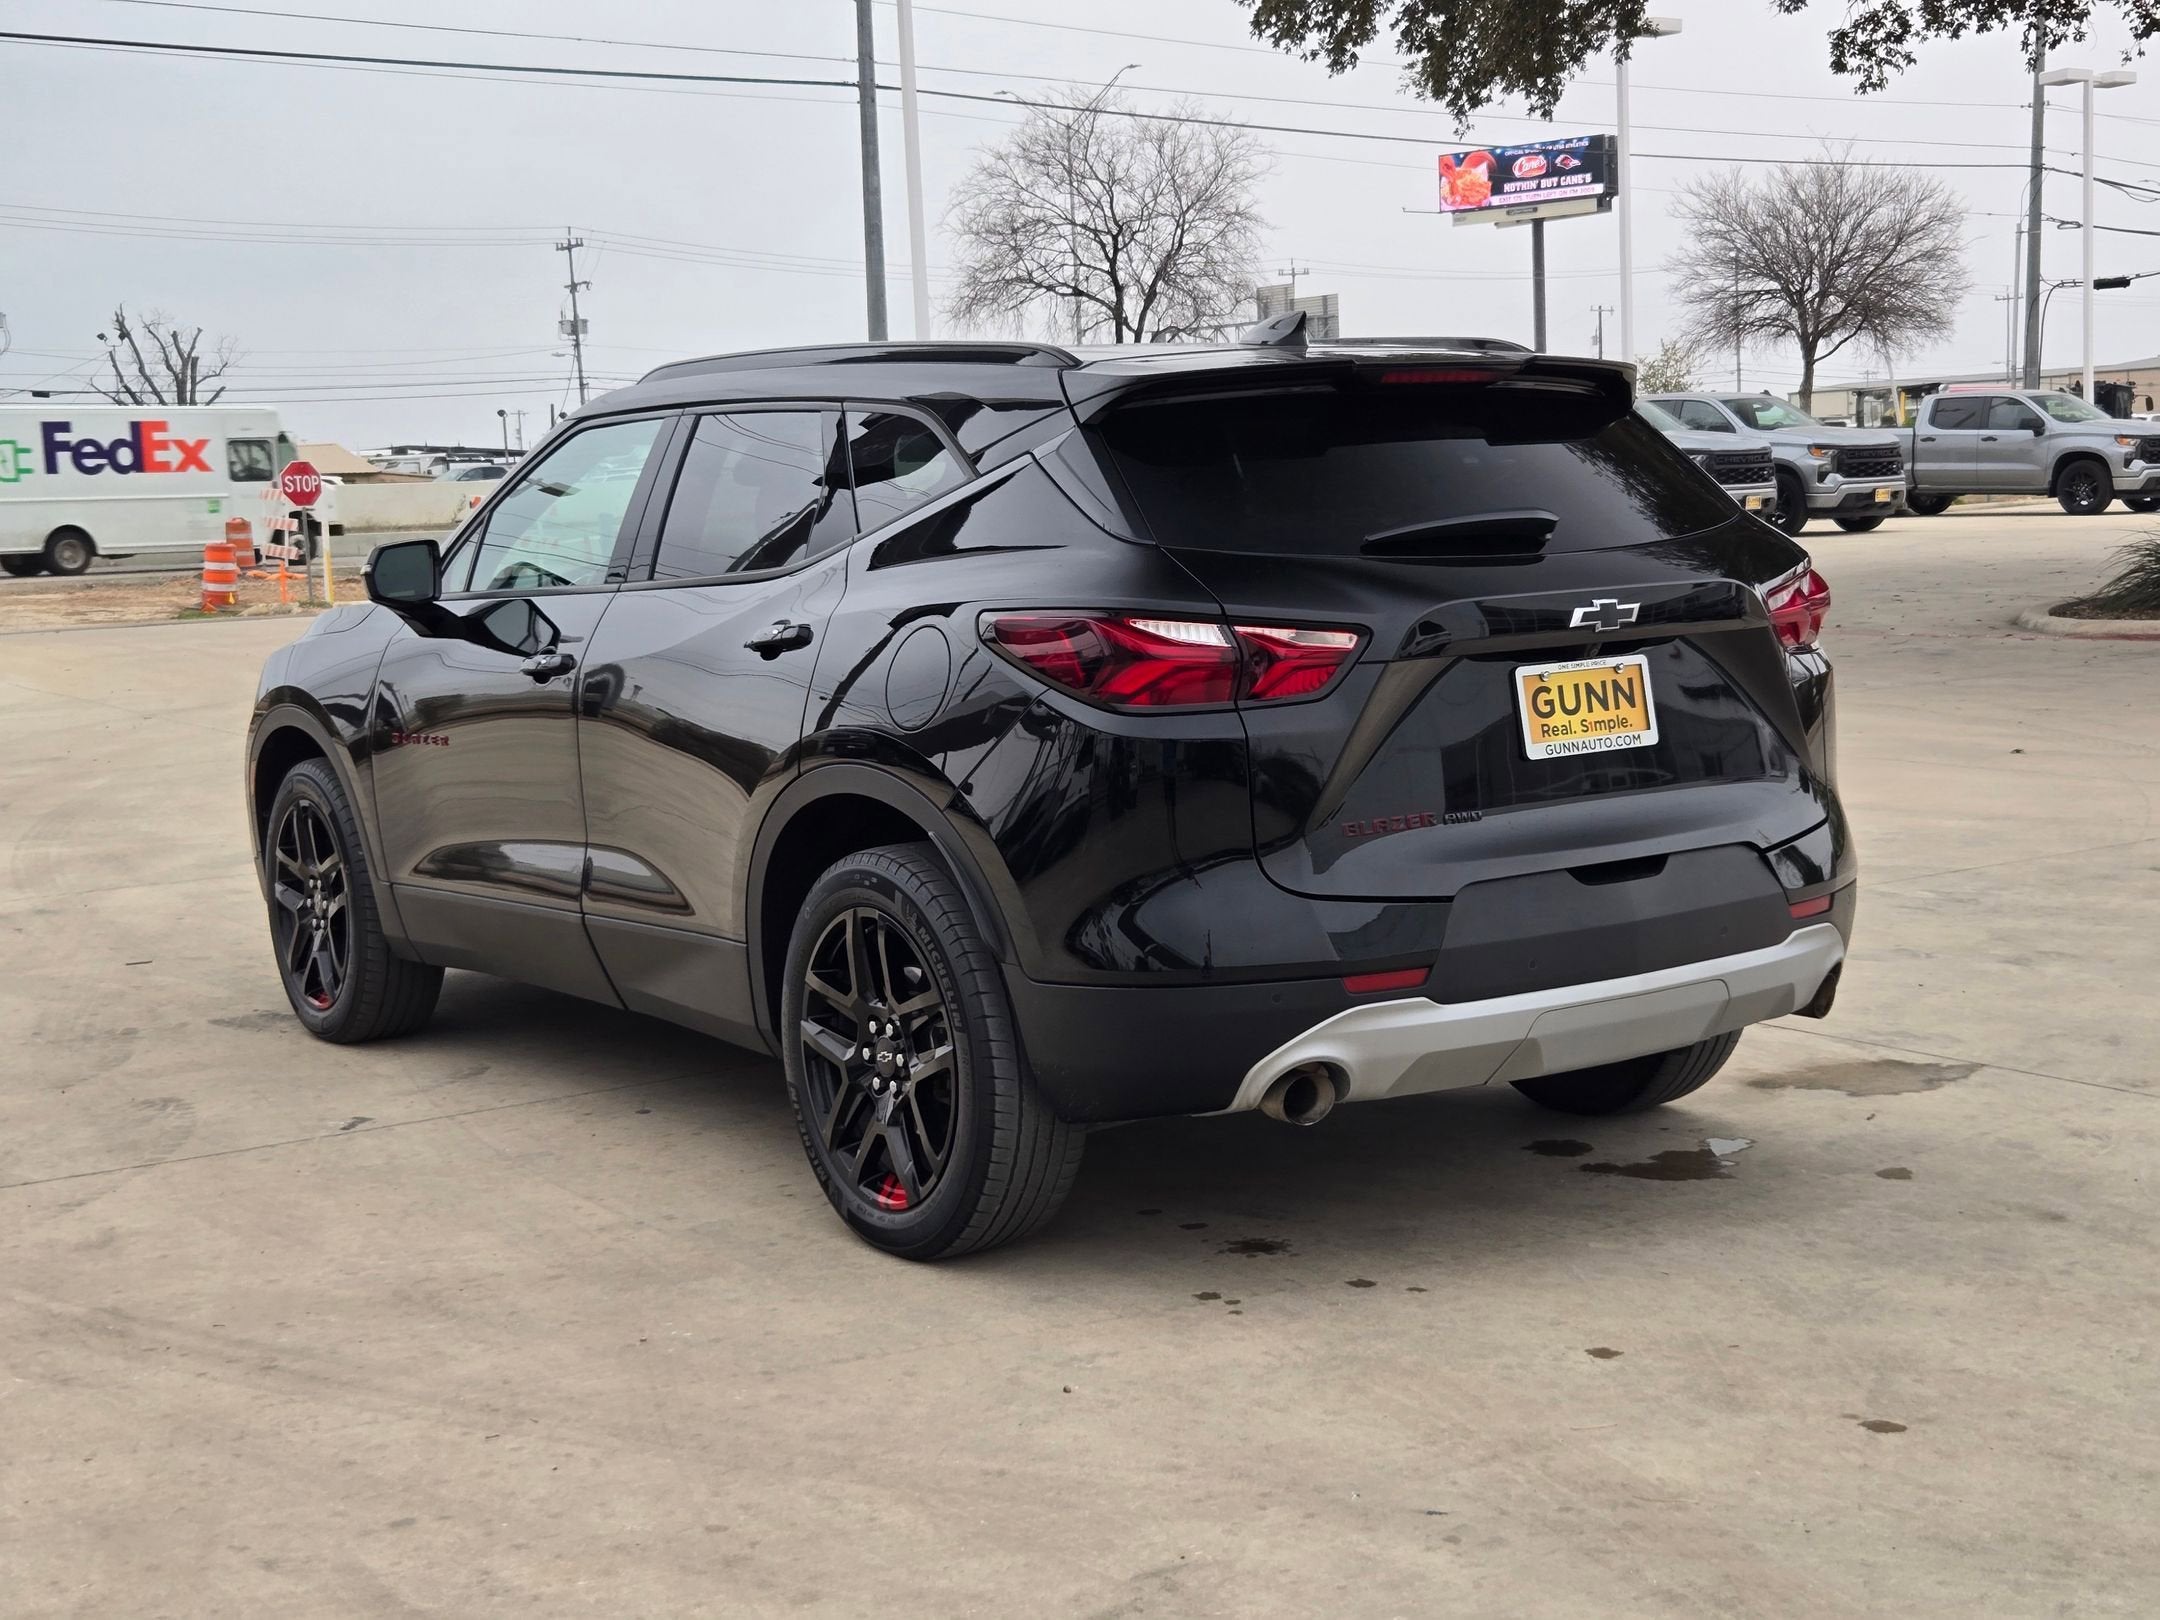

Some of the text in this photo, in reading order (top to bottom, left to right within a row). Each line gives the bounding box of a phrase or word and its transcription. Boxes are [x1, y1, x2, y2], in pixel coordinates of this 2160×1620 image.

[1540, 177, 1559, 189] BUT
[1560, 173, 1592, 186] CANE'S
[40, 420, 214, 475] FedEx
[285, 475, 320, 494] STOP
[1532, 677, 1637, 719] GUNN
[1541, 720, 1577, 738] Real.
[1545, 734, 1642, 756] GUNNAUTO.COM
[1342, 811, 1438, 837] BLAZER
